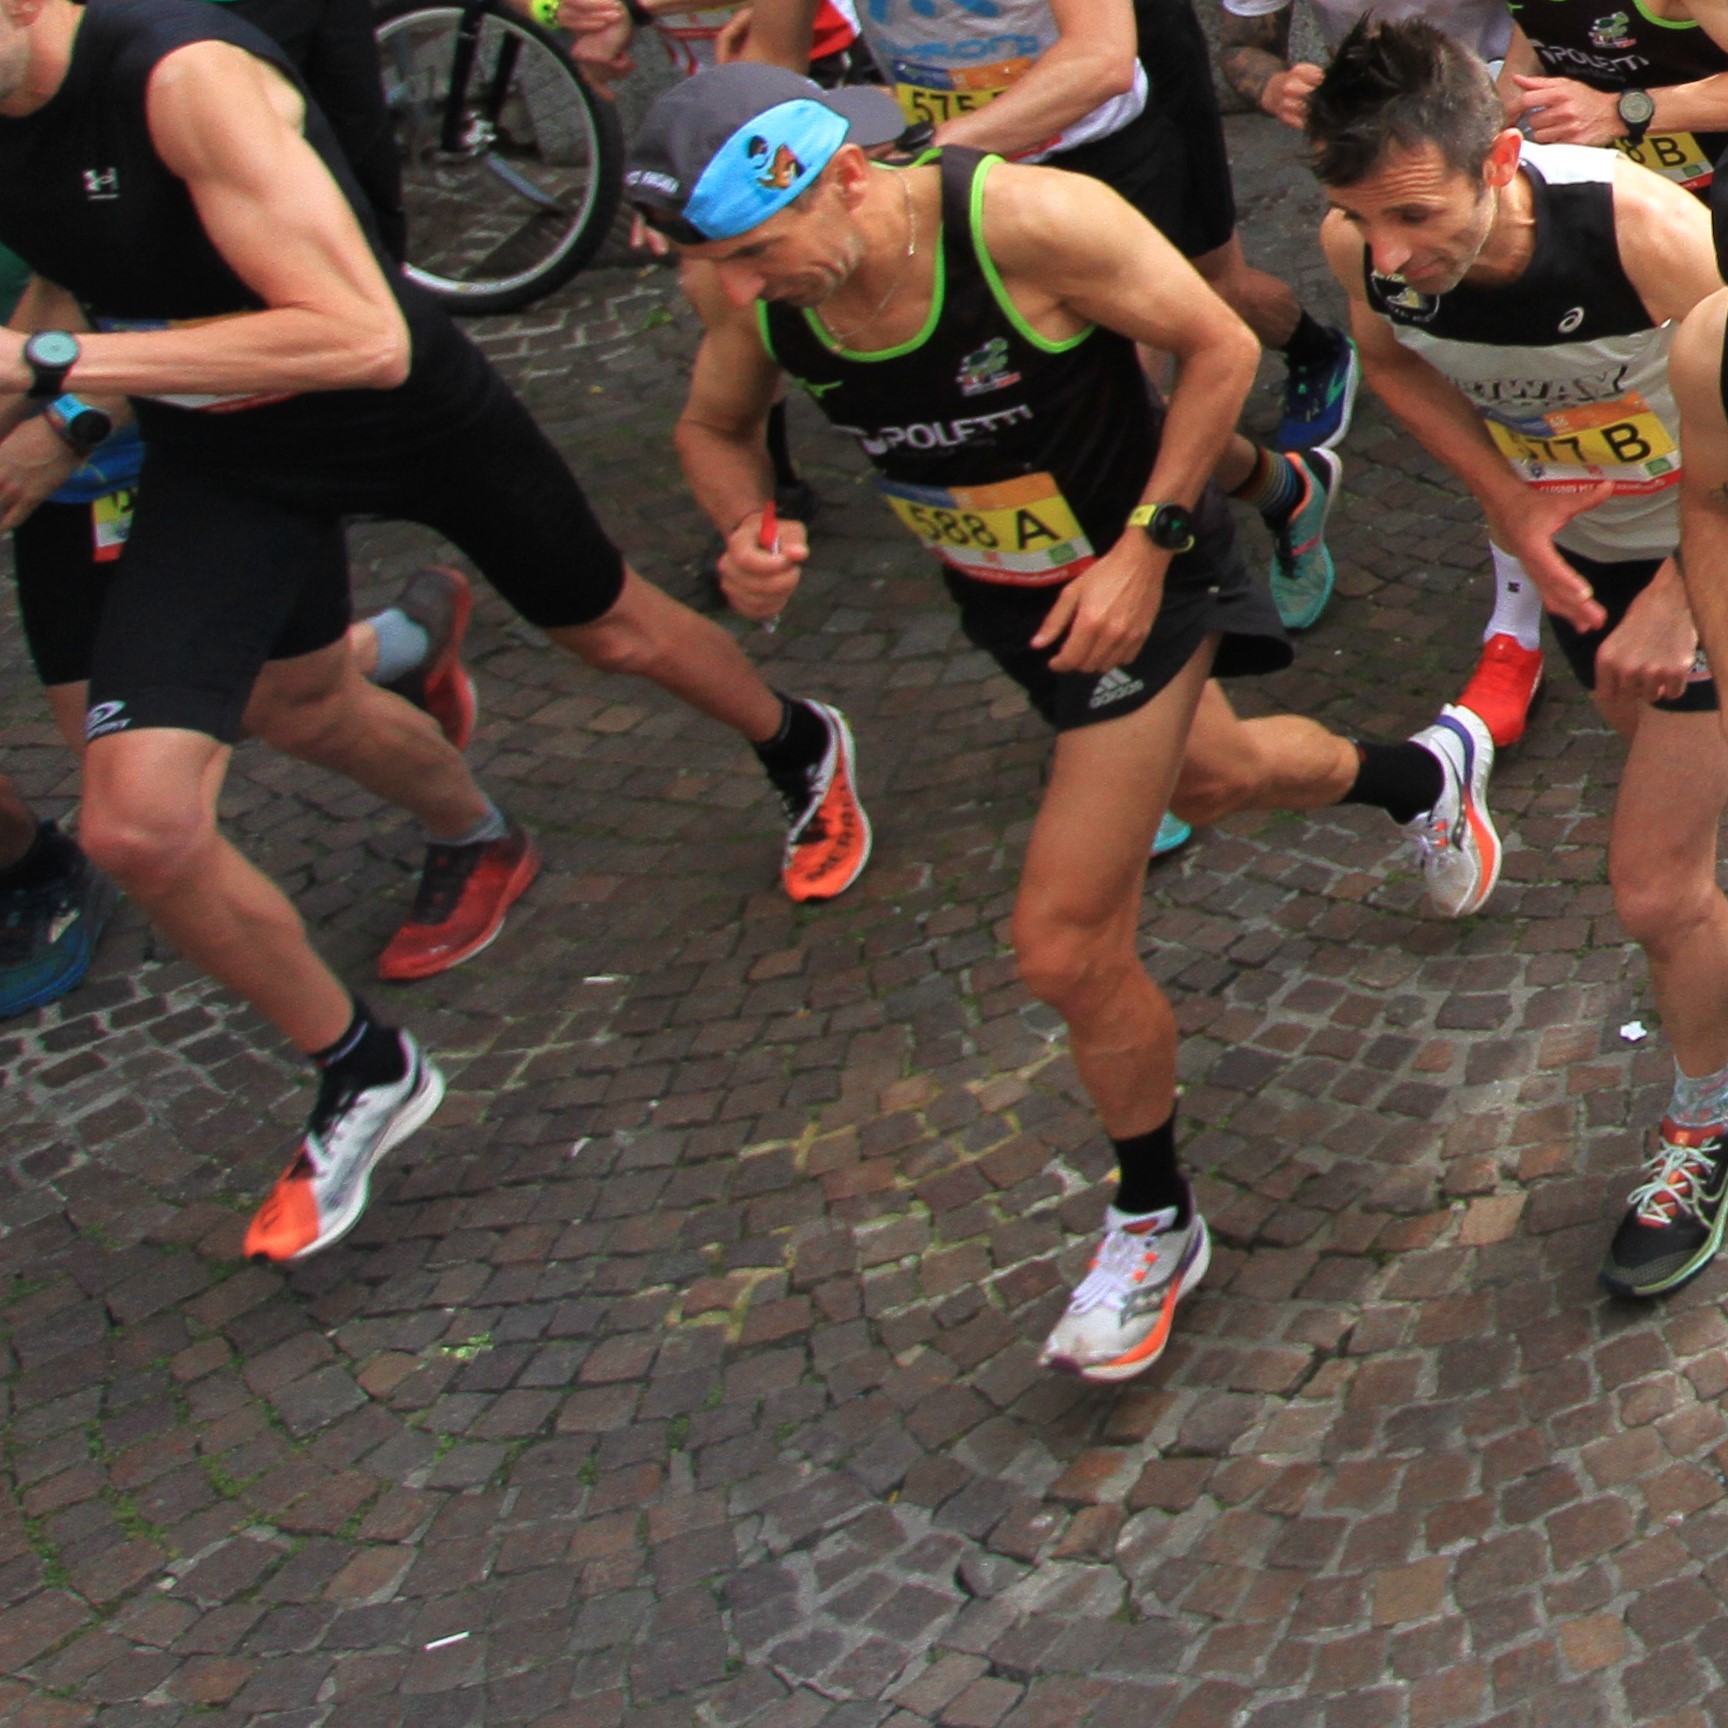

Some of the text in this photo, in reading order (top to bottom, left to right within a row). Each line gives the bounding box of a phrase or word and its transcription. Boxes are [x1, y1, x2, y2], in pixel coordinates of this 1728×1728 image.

[1650, 136, 1687, 167] B
[1601, 422, 1652, 463] B
[909, 505, 1060, 551] 588 A
